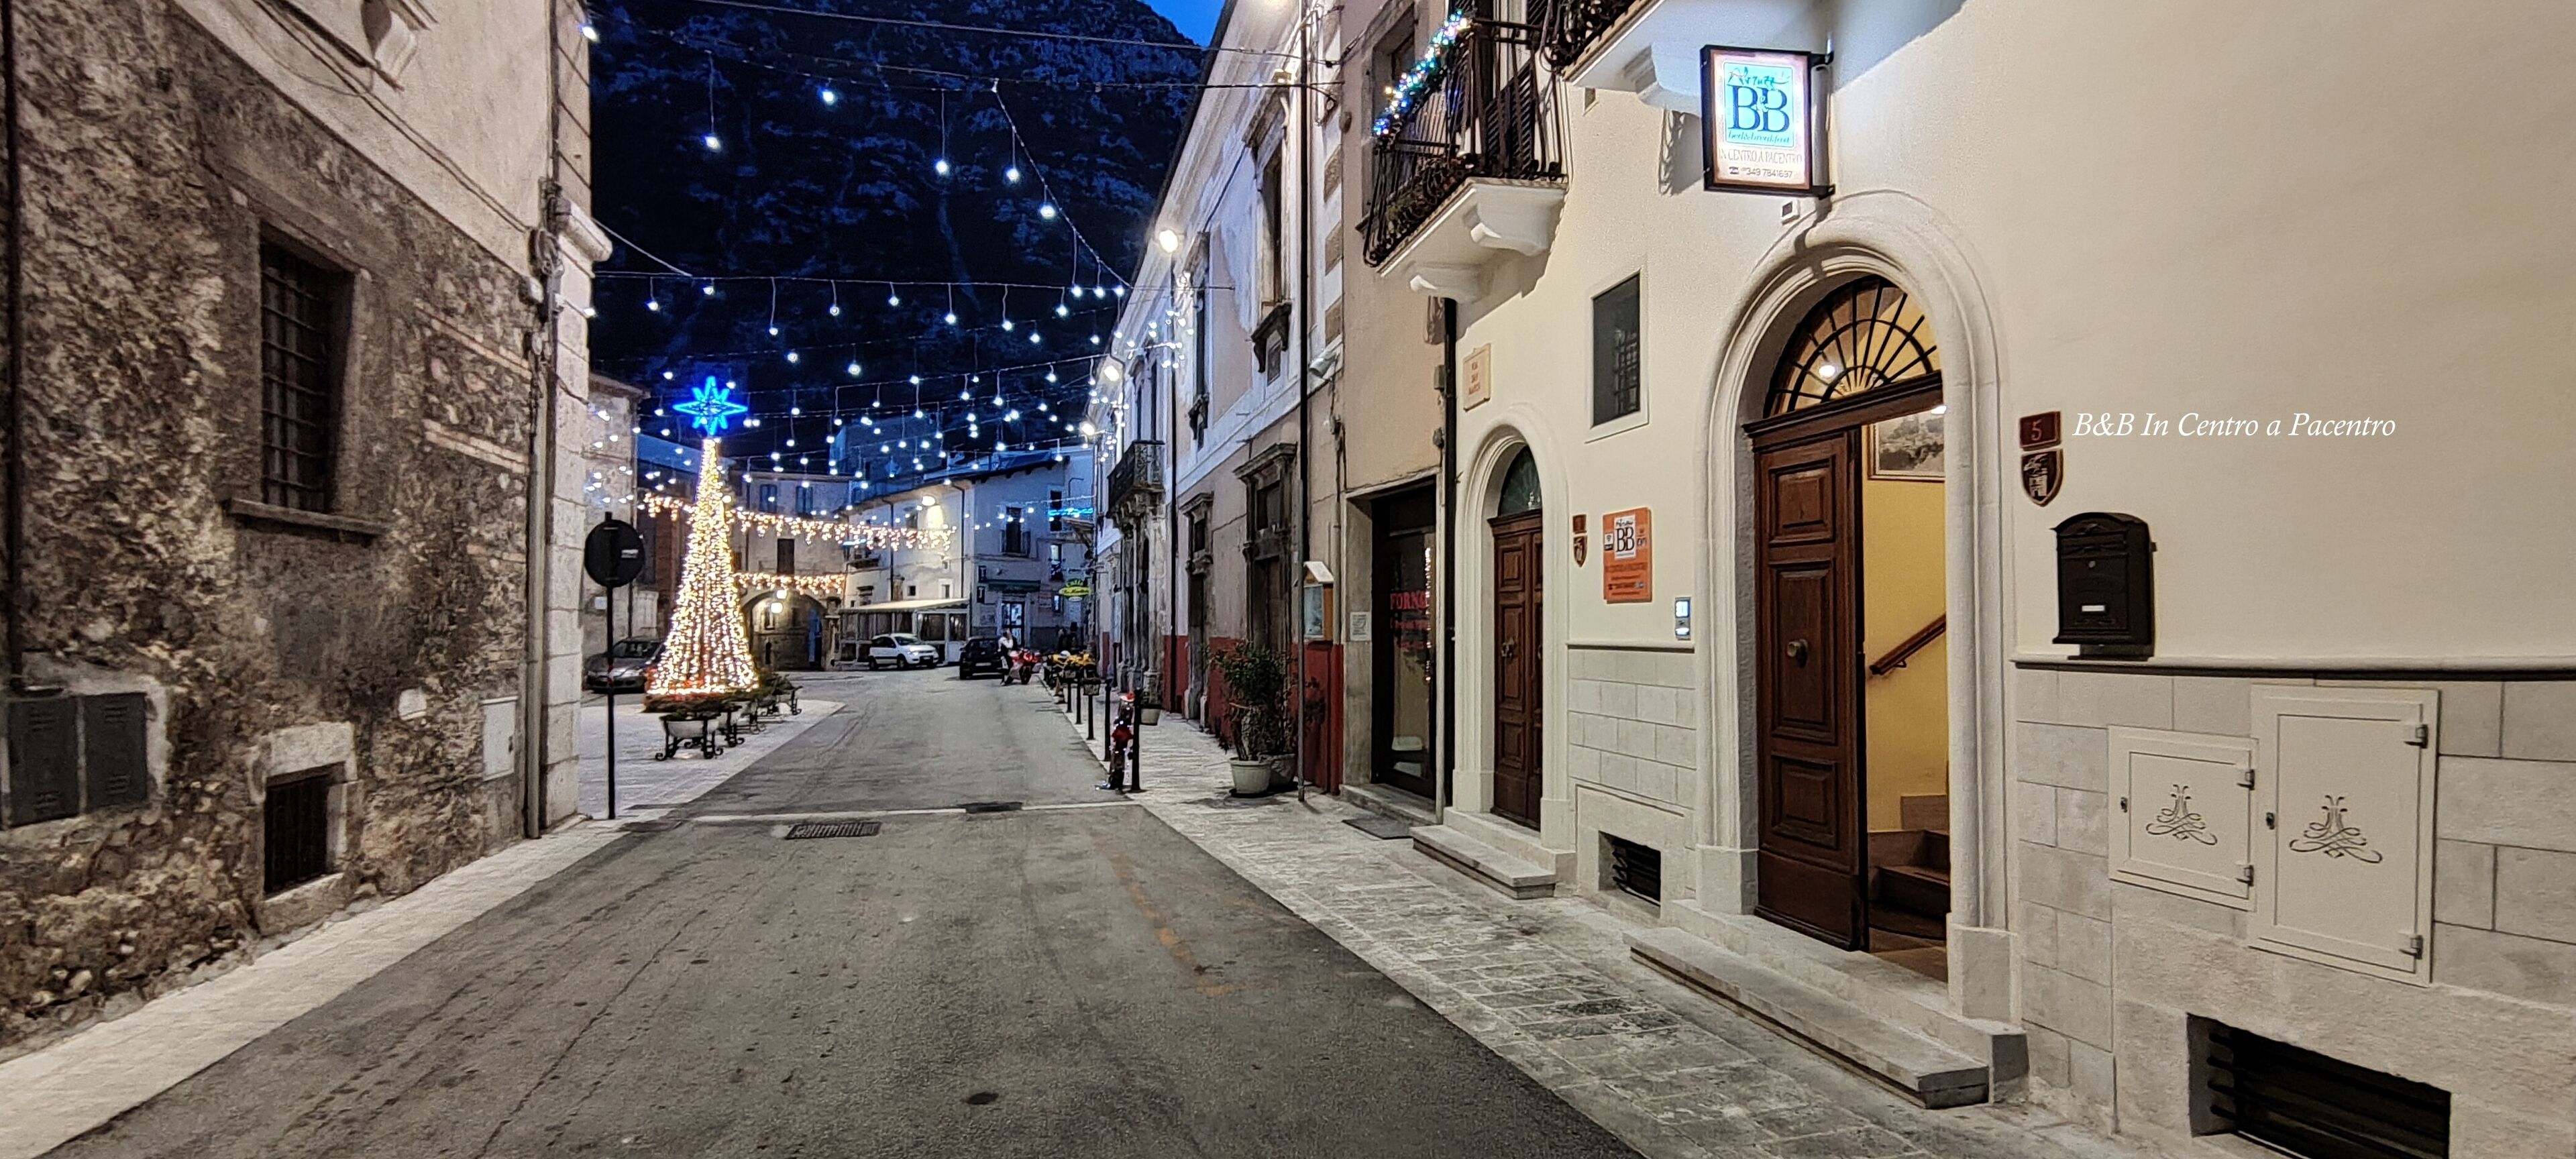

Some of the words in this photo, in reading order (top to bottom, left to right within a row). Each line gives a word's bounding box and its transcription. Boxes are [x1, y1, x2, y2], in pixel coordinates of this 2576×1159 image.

[1727, 149, 1758, 162] CENTRO
[1758, 152, 1764, 162] A
[1765, 152, 1803, 164] PACENTRO
[2030, 419, 2043, 441] 5
